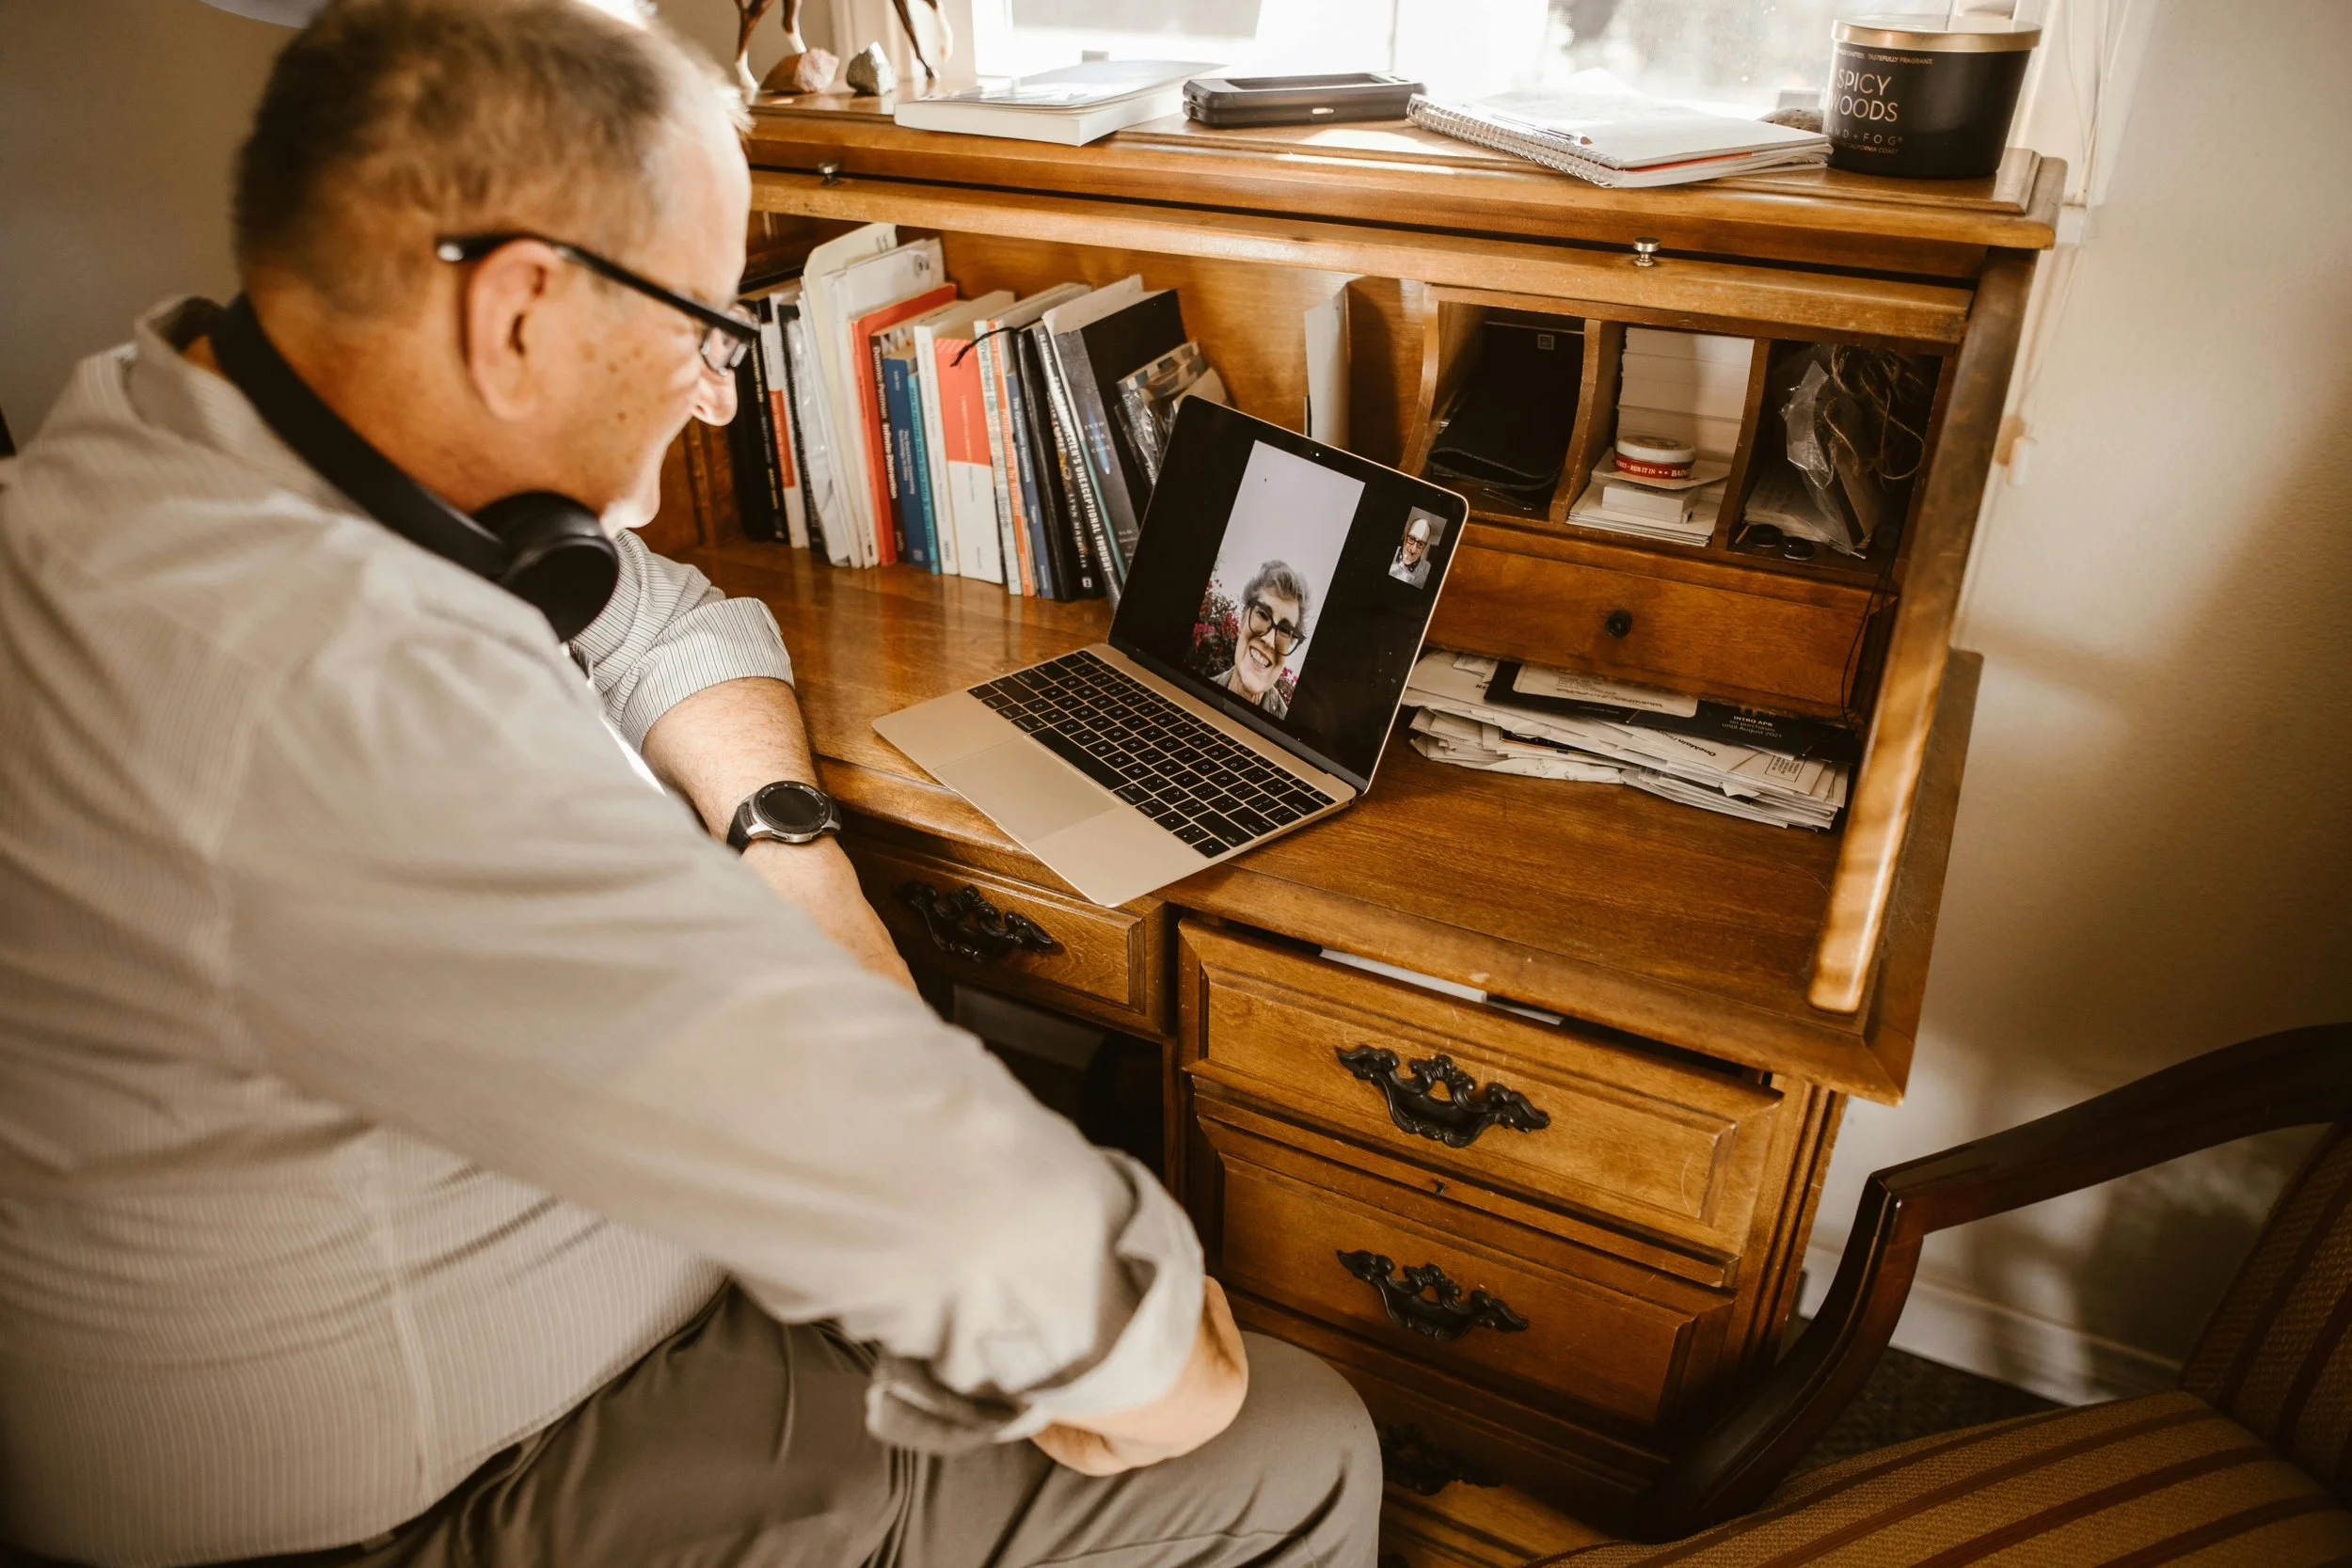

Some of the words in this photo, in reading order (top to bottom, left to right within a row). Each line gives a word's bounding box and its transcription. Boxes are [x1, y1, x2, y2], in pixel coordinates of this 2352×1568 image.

[1837, 69, 1892, 96] SPICY
[1829, 91, 1899, 122] WOODS
[872, 346, 884, 384] Dominic
[882, 423, 893, 454] Infinite
[1084, 421, 1104, 430] INTO
[886, 453, 898, 499] Distraction
[1629, 465, 1642, 473] RUB
[1066, 492, 1078, 517] LYNN
[1074, 465, 1102, 533] UNEXCEPTIONAL
[1093, 534, 1113, 572] THOUGHT
[1071, 520, 1089, 568] MARGULIS
[1722, 722, 1738, 731] until
[1740, 726, 1764, 736] August
[1765, 730, 1782, 738] 2021
[1733, 716, 1756, 724] INTRO
[1740, 721, 1775, 732] purchases
[1677, 738, 1716, 756] OneMain
